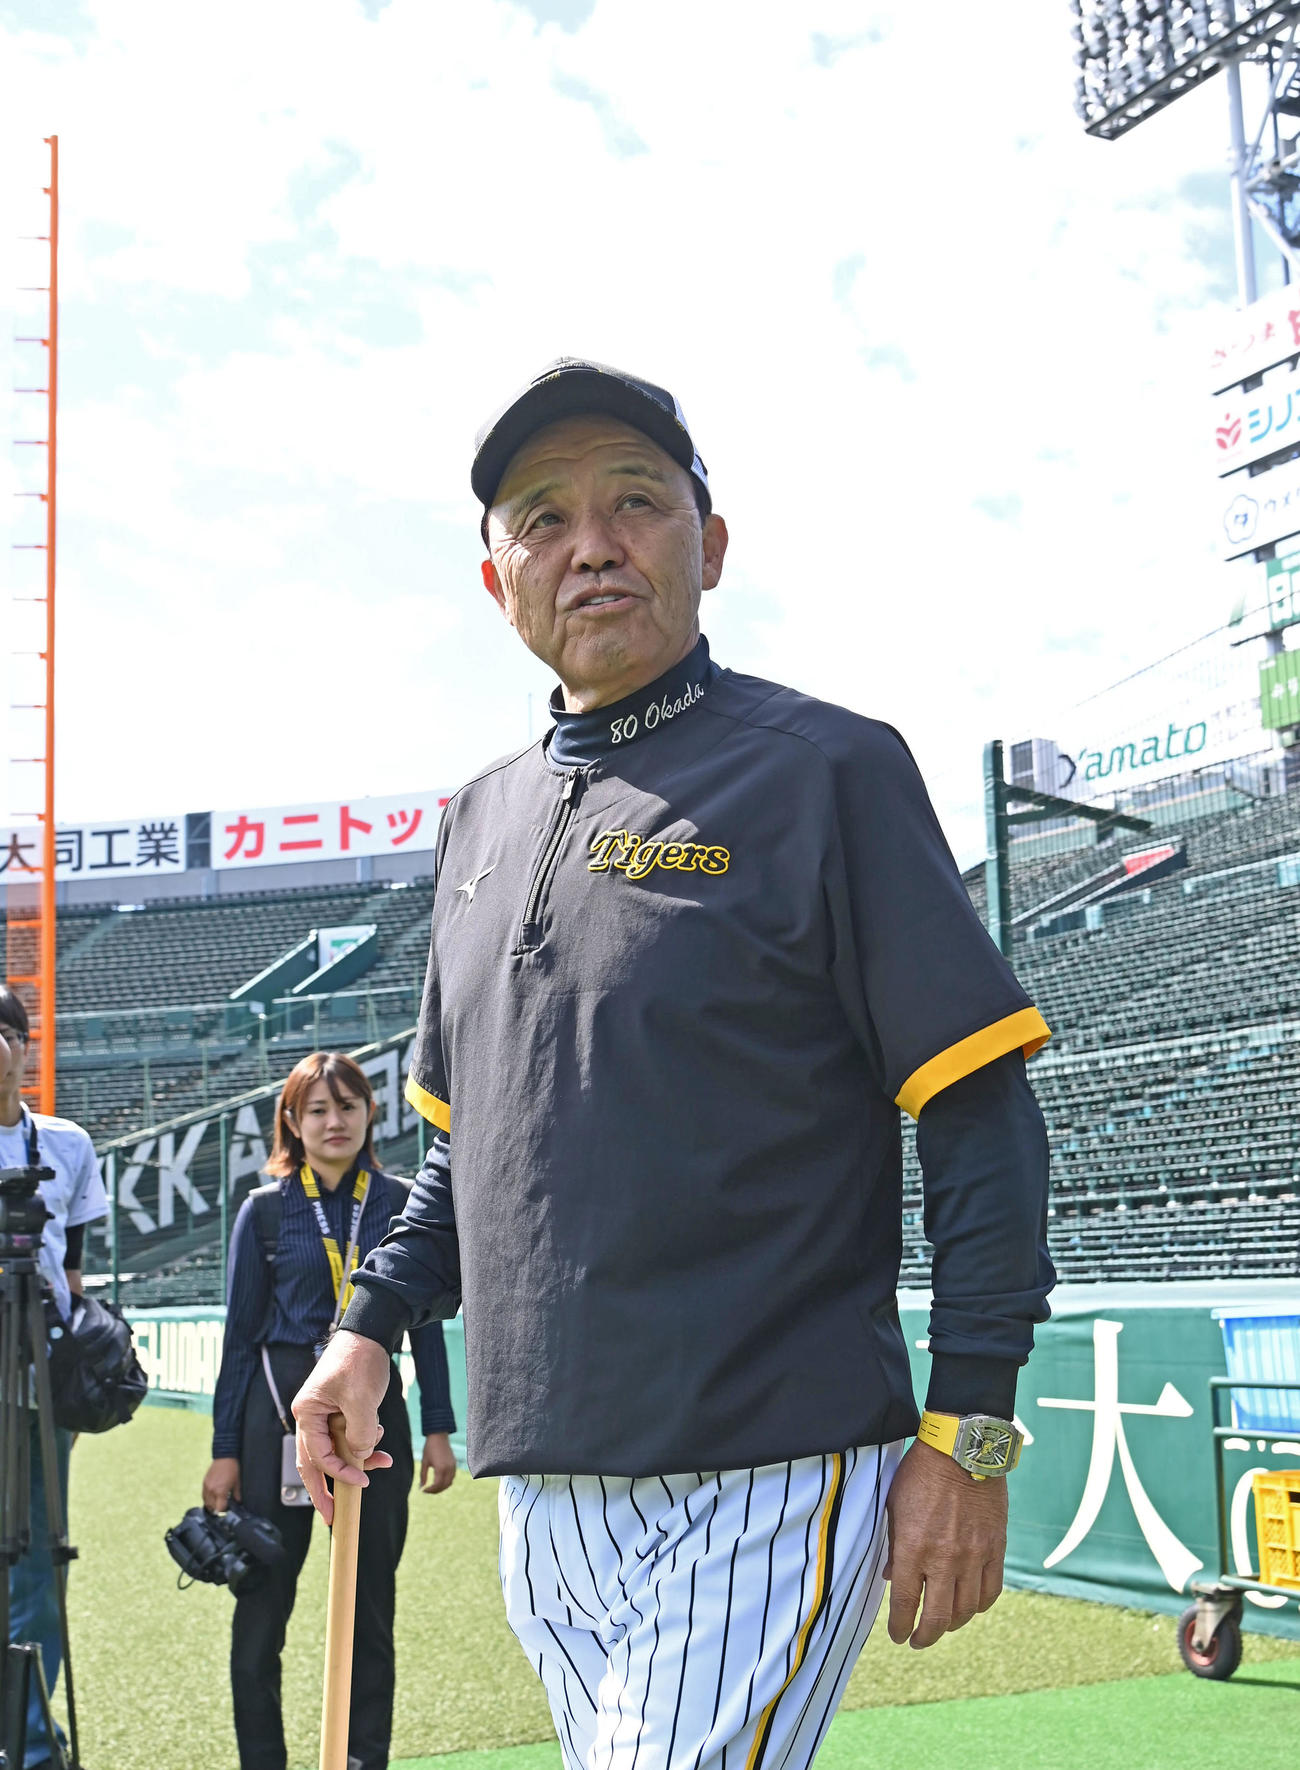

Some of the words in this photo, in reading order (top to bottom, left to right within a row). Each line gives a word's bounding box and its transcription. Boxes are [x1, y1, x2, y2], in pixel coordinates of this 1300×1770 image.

[1248, 388, 1300, 444] シノ
[610, 714, 638, 744] 80
[644, 682, 705, 729] Okada
[1079, 721, 1207, 782] amato
[223, 796, 456, 862] カニトッ
[587, 829, 731, 880] Tigers
